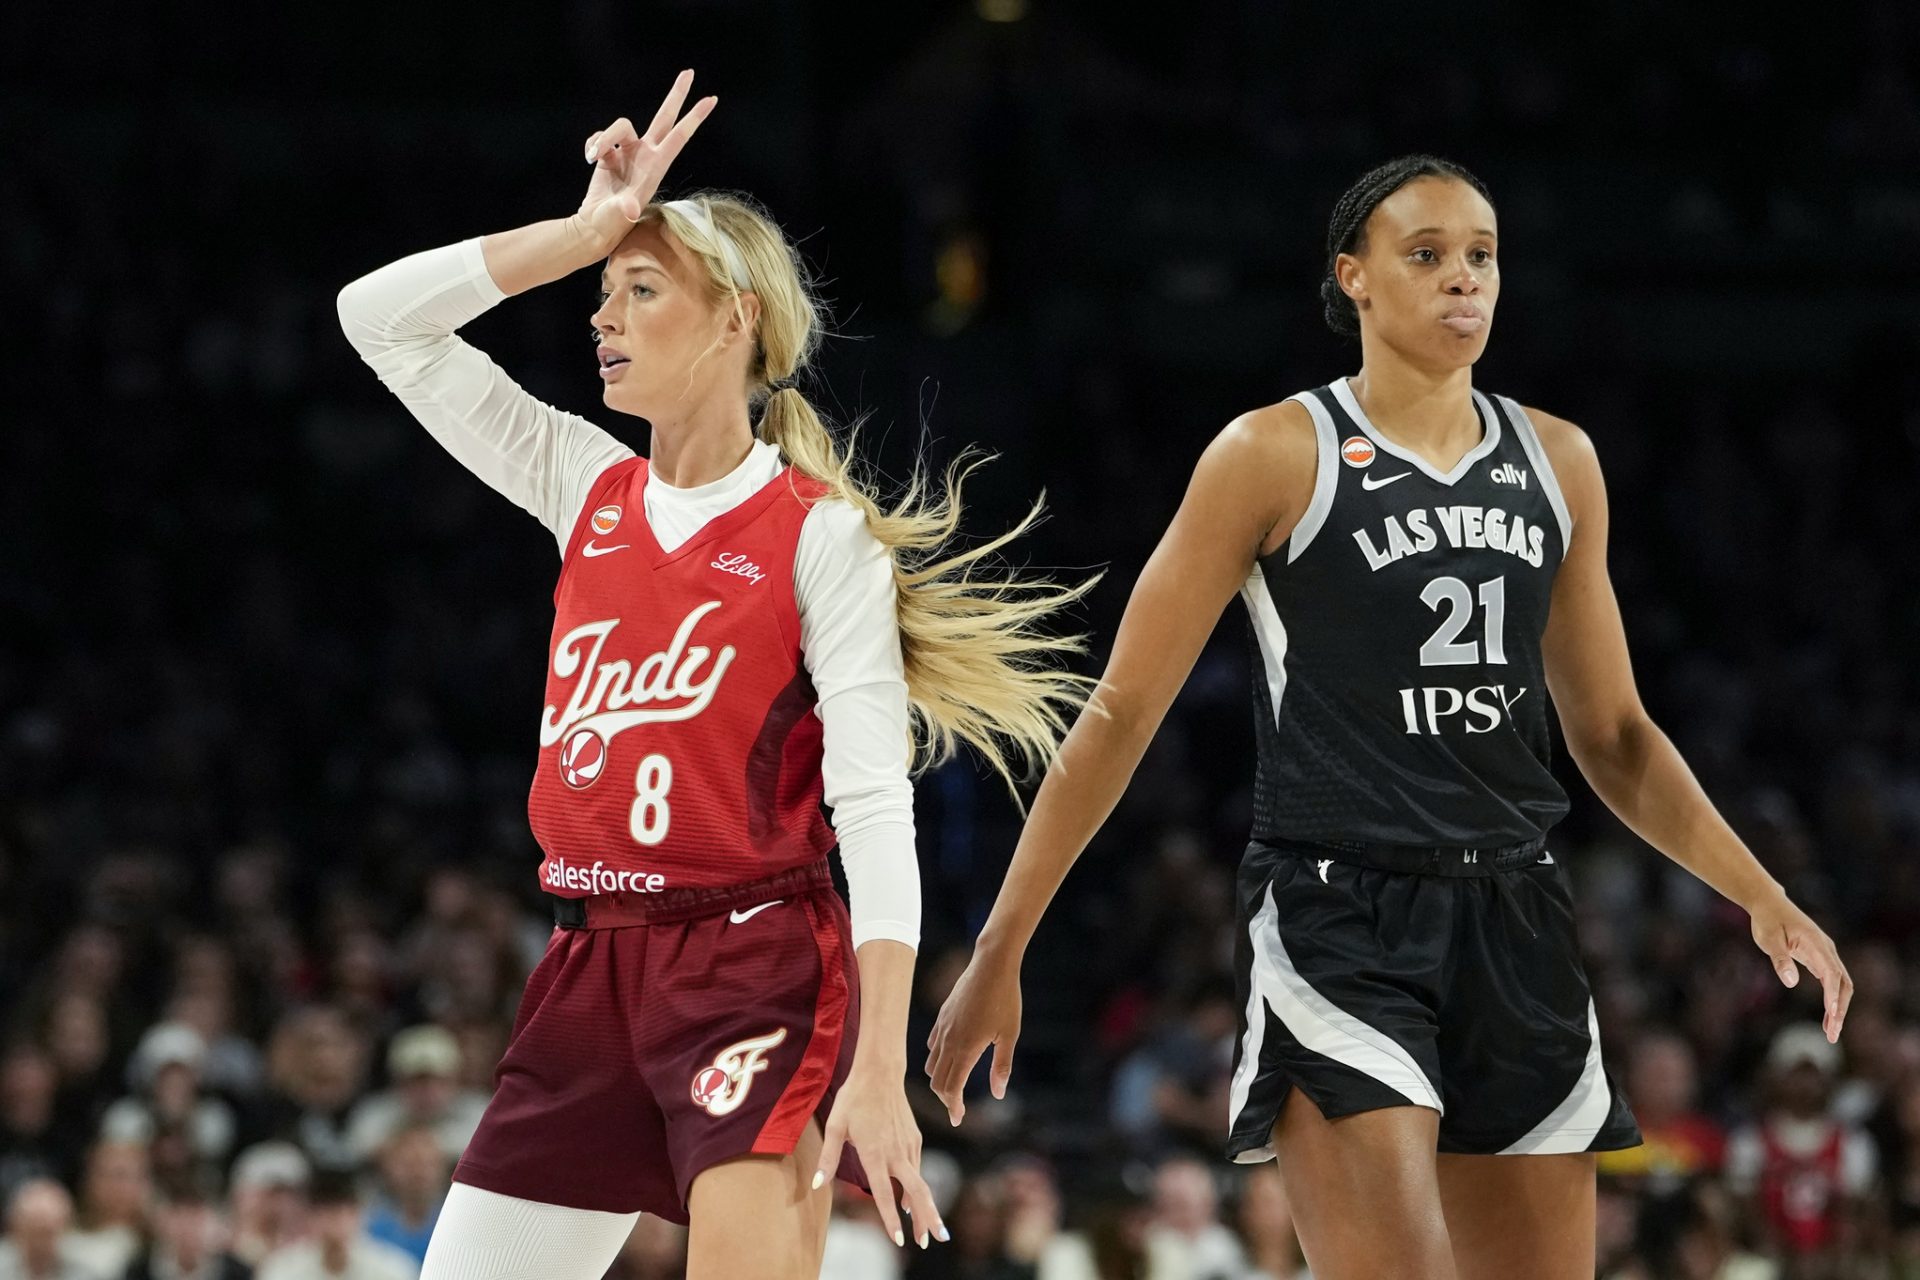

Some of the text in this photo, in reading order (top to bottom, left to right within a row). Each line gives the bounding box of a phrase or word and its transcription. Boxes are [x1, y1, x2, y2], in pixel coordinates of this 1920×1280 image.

[1490, 463, 1527, 490] ally
[1352, 506, 1545, 572] LAS VEGAS
[711, 552, 767, 585] Lilly
[1419, 575, 1508, 666] 21
[540, 600, 736, 748] Indy
[1399, 685, 1527, 735] IPSY
[629, 753, 673, 846] 8
[546, 857, 665, 894] salesforce
